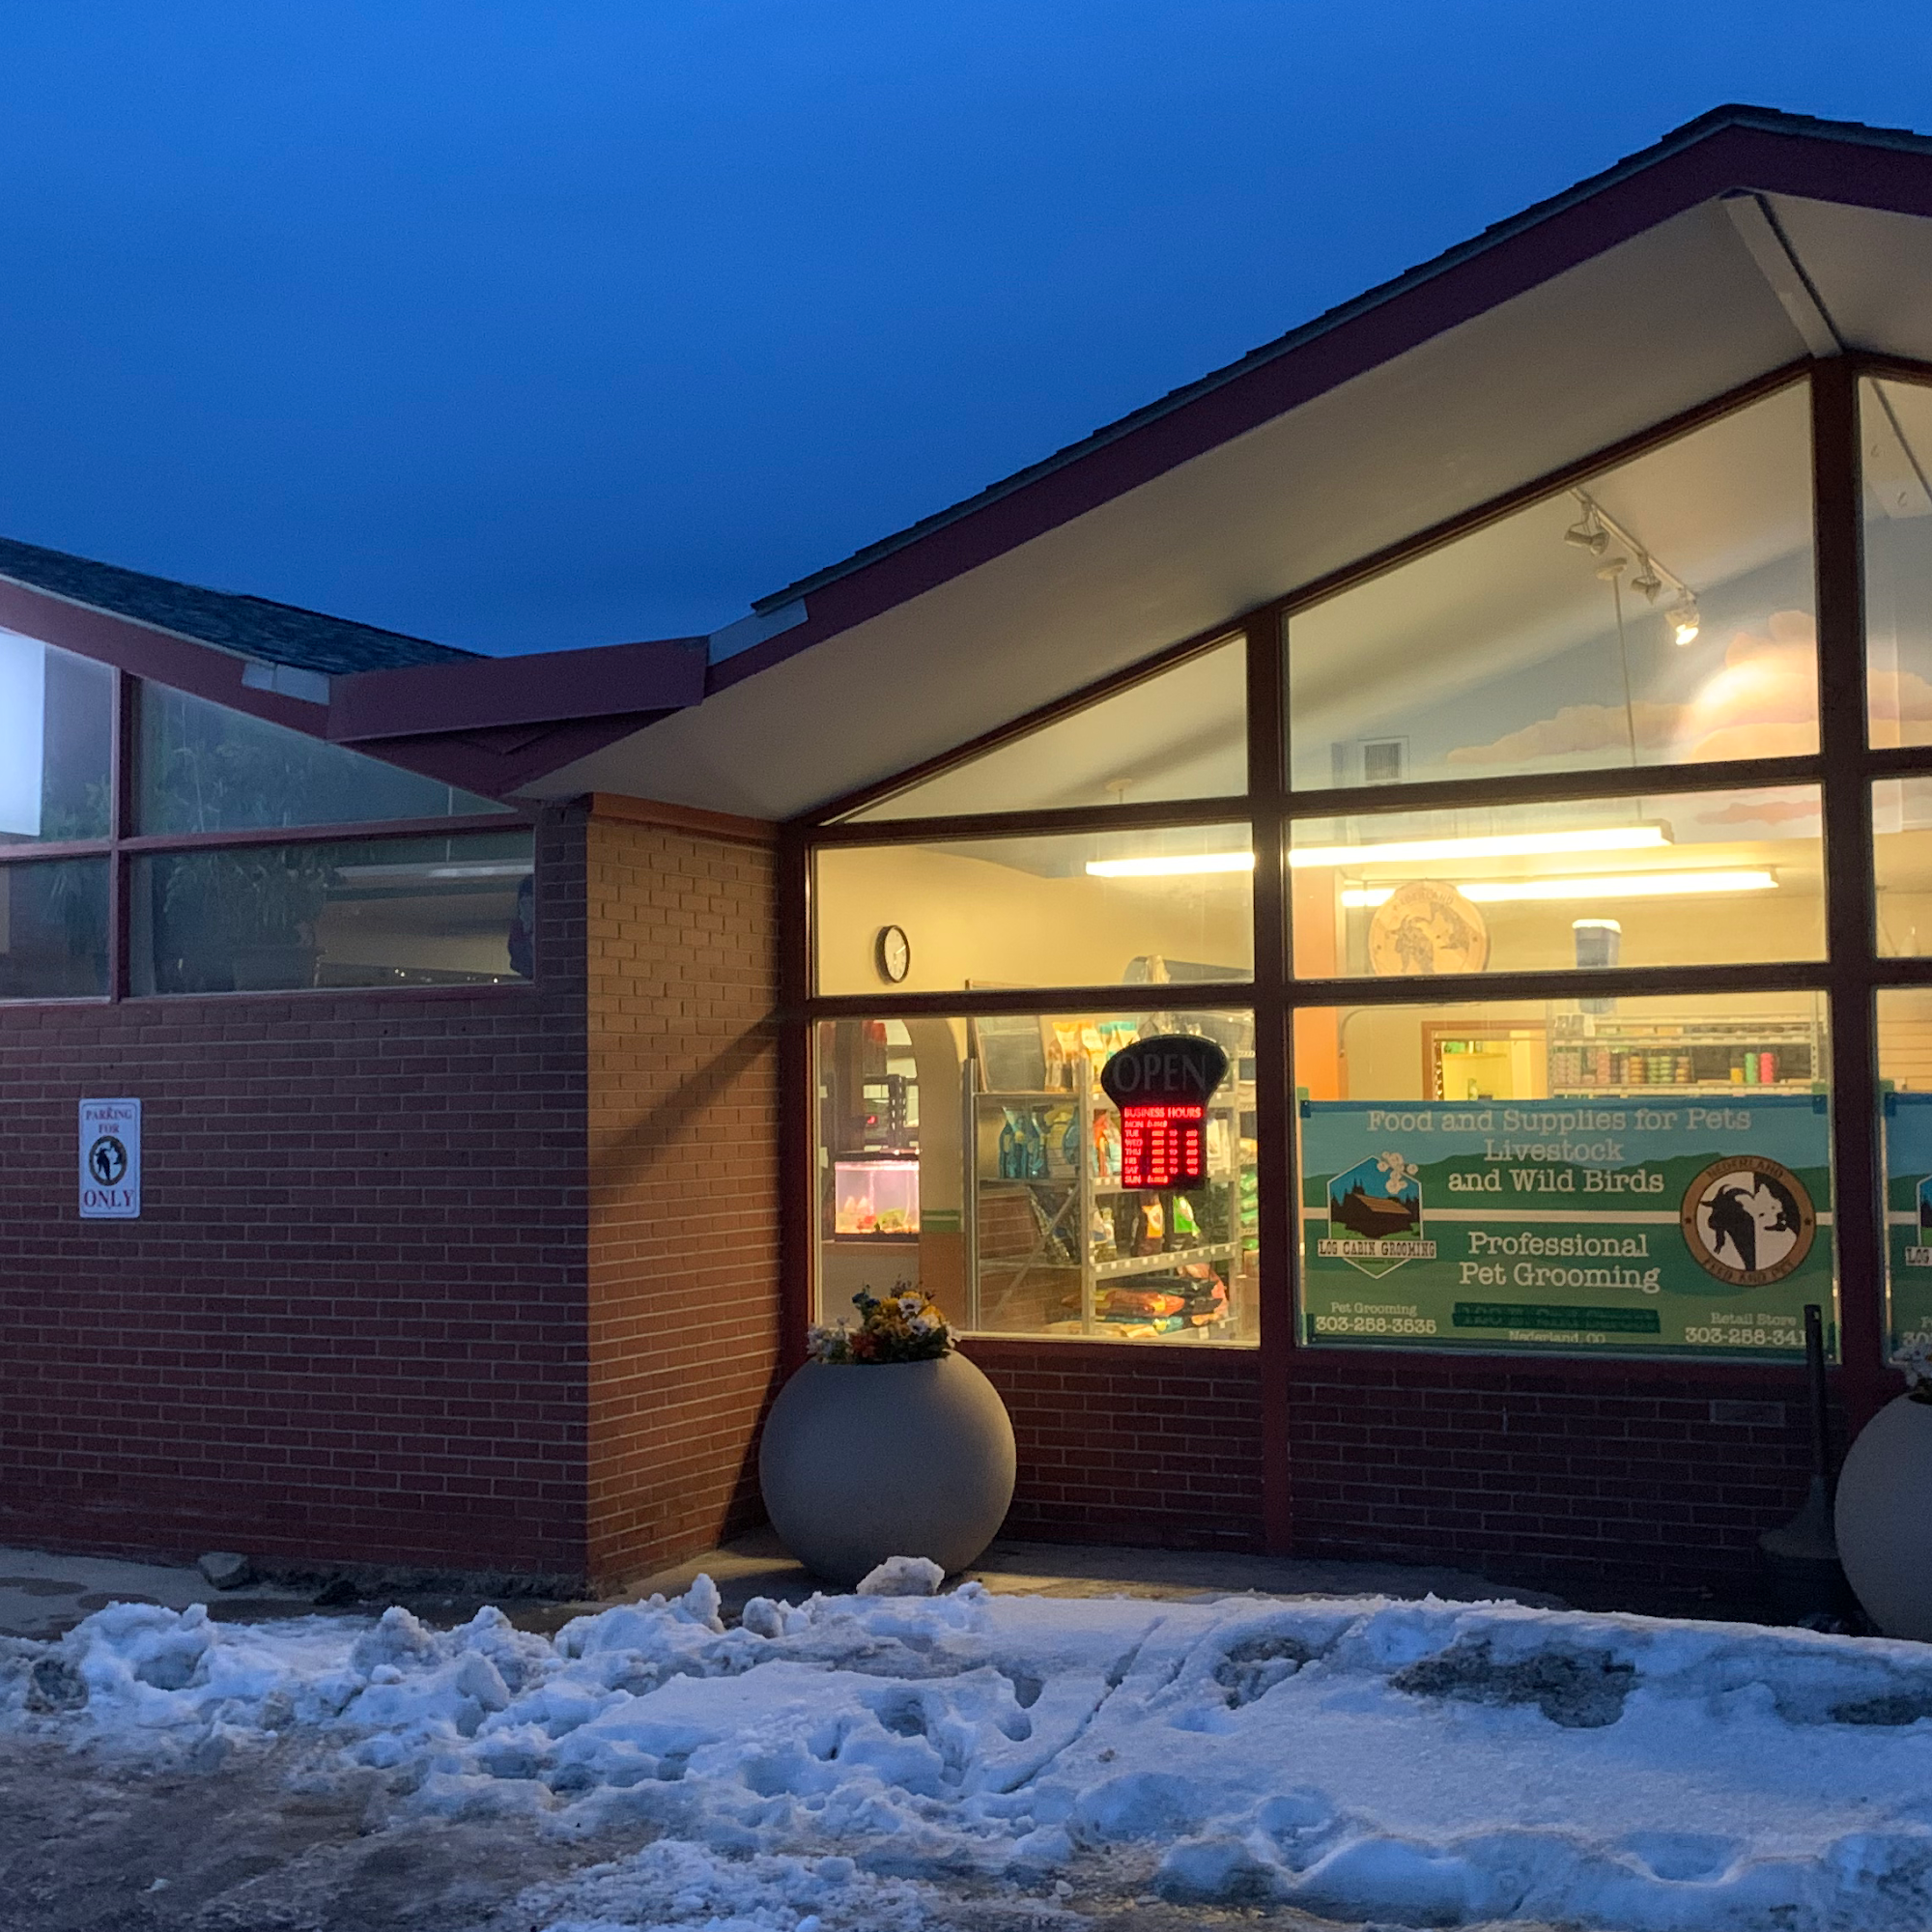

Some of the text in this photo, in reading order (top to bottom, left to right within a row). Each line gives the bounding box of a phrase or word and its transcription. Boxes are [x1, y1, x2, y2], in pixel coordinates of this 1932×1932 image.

[1113, 1053, 1208, 1093] OPEN
[85, 1108, 132, 1121] PARKING
[1123, 1106, 1202, 1118] BUSINESS HOURS
[99, 1123, 120, 1133] FOR
[1367, 1108, 1751, 1135] Food and Supplies for Pets
[1124, 1138, 1143, 1147] WED
[1484, 1139, 1625, 1161] Livestock
[1124, 1165, 1139, 1174] SAT
[1124, 1175, 1142, 1184] SUN
[1448, 1168, 1664, 1192] and Wild Birds
[83, 1189, 134, 1208] ONLY
[1319, 1241, 1435, 1257] LOG CABIN GROOMING
[1467, 1231, 1650, 1257] Professional
[1459, 1262, 1661, 1293] Pet Grooming
[1331, 1301, 1417, 1317] Pet Grooming
[1711, 1312, 1797, 1326] Retail Store
[1685, 1327, 1807, 1346] 303-258-341
